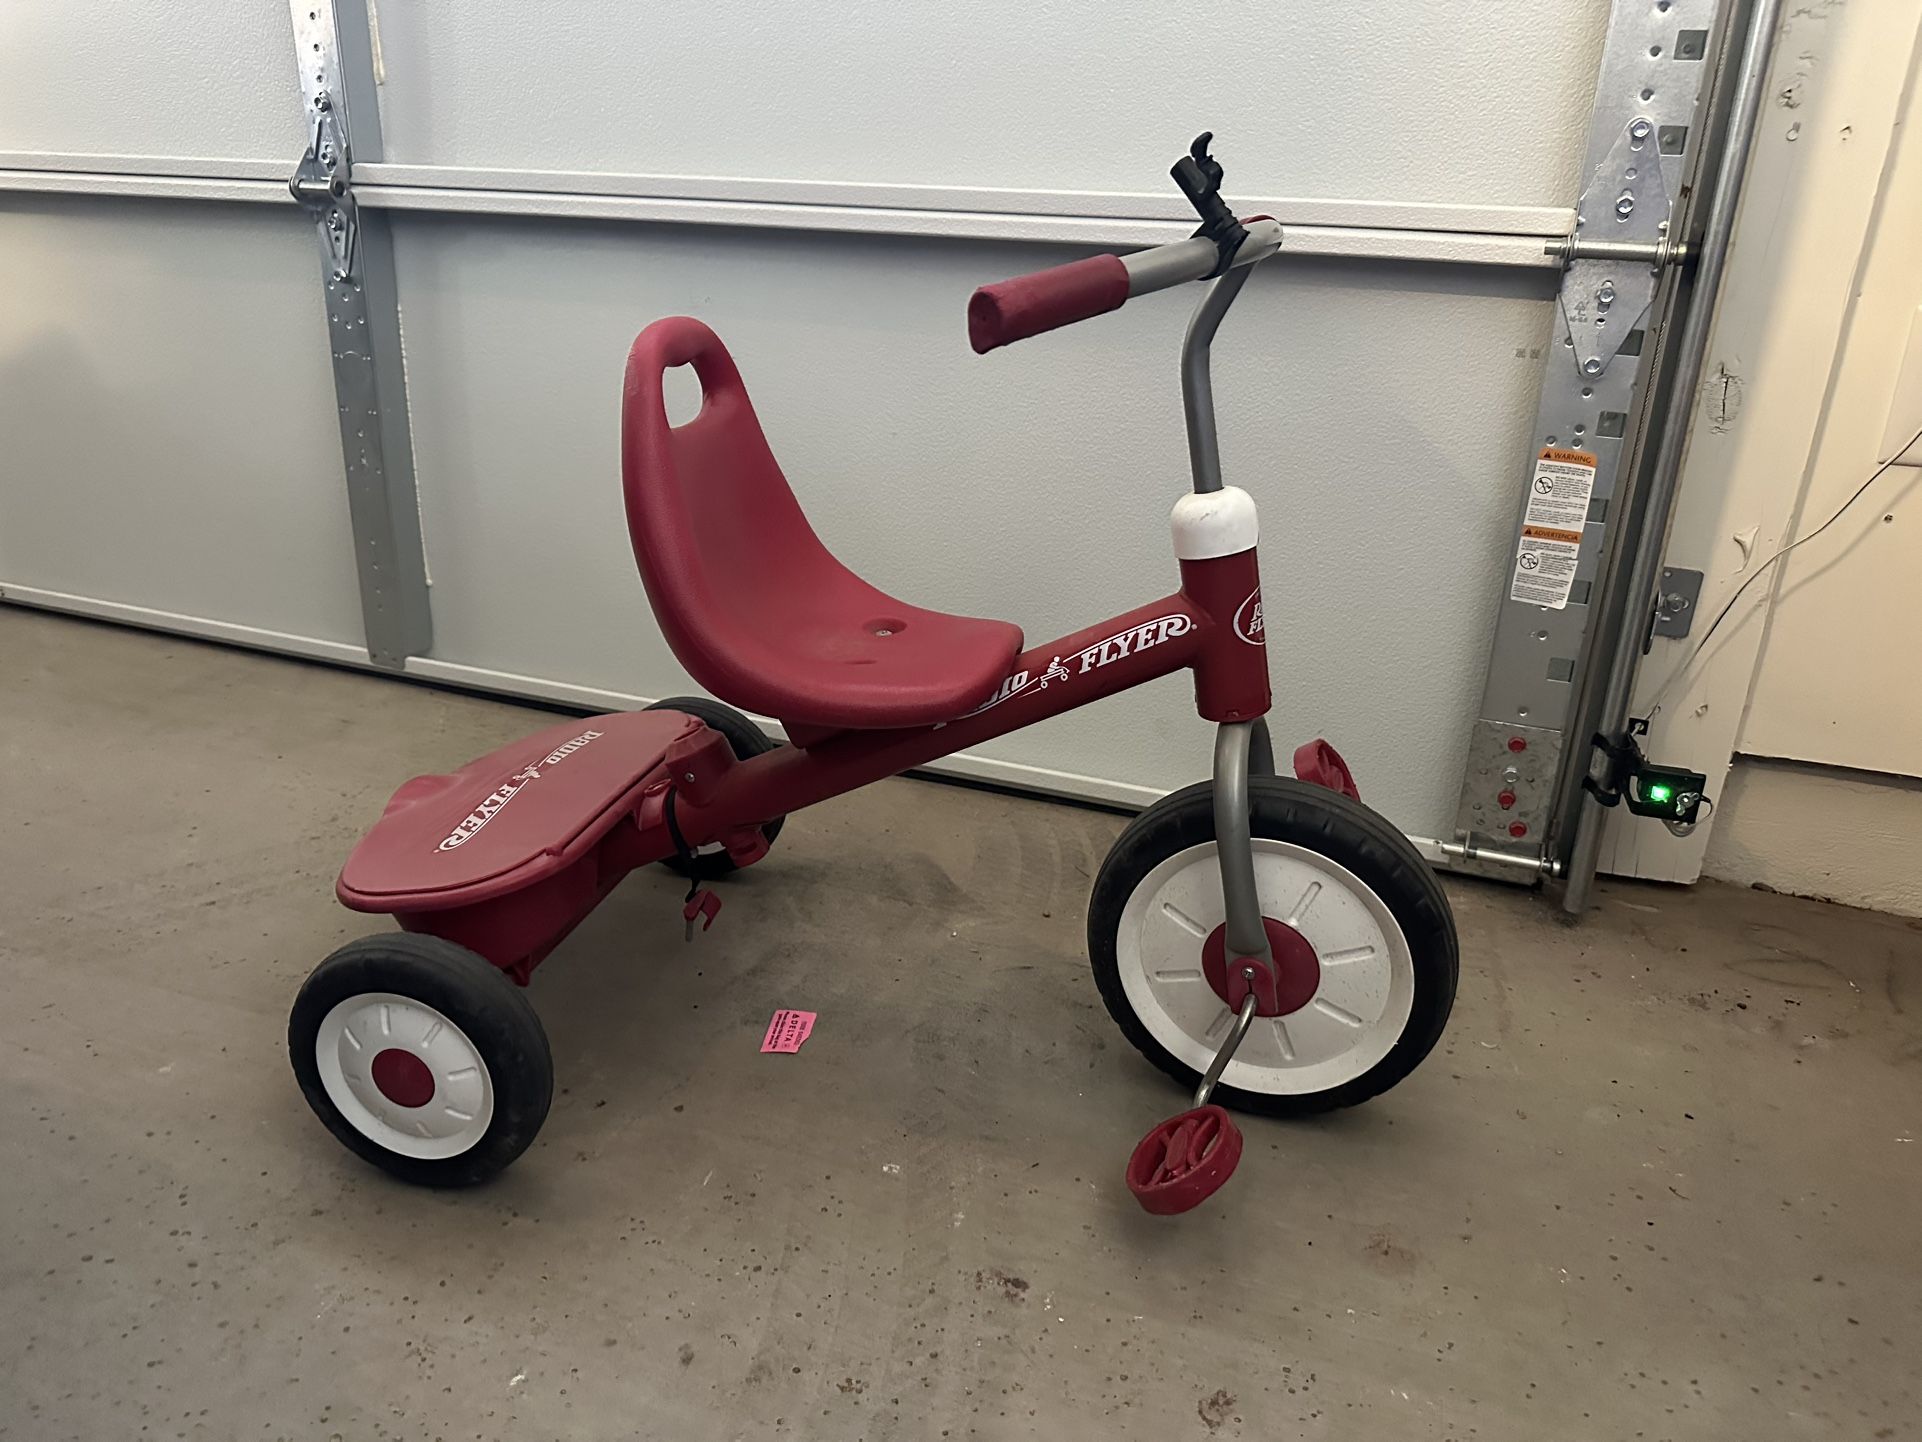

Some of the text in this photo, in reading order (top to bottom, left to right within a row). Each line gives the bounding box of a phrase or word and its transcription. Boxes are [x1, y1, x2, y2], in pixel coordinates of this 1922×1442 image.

[1554, 452, 1592, 464] WARNING
[1533, 530, 1578, 541] ADVERTENCIA
[1079, 614, 1191, 674] FLYER
[439, 731, 605, 850] RADIO FLYER
[785, 1020, 799, 1042] DELTA
